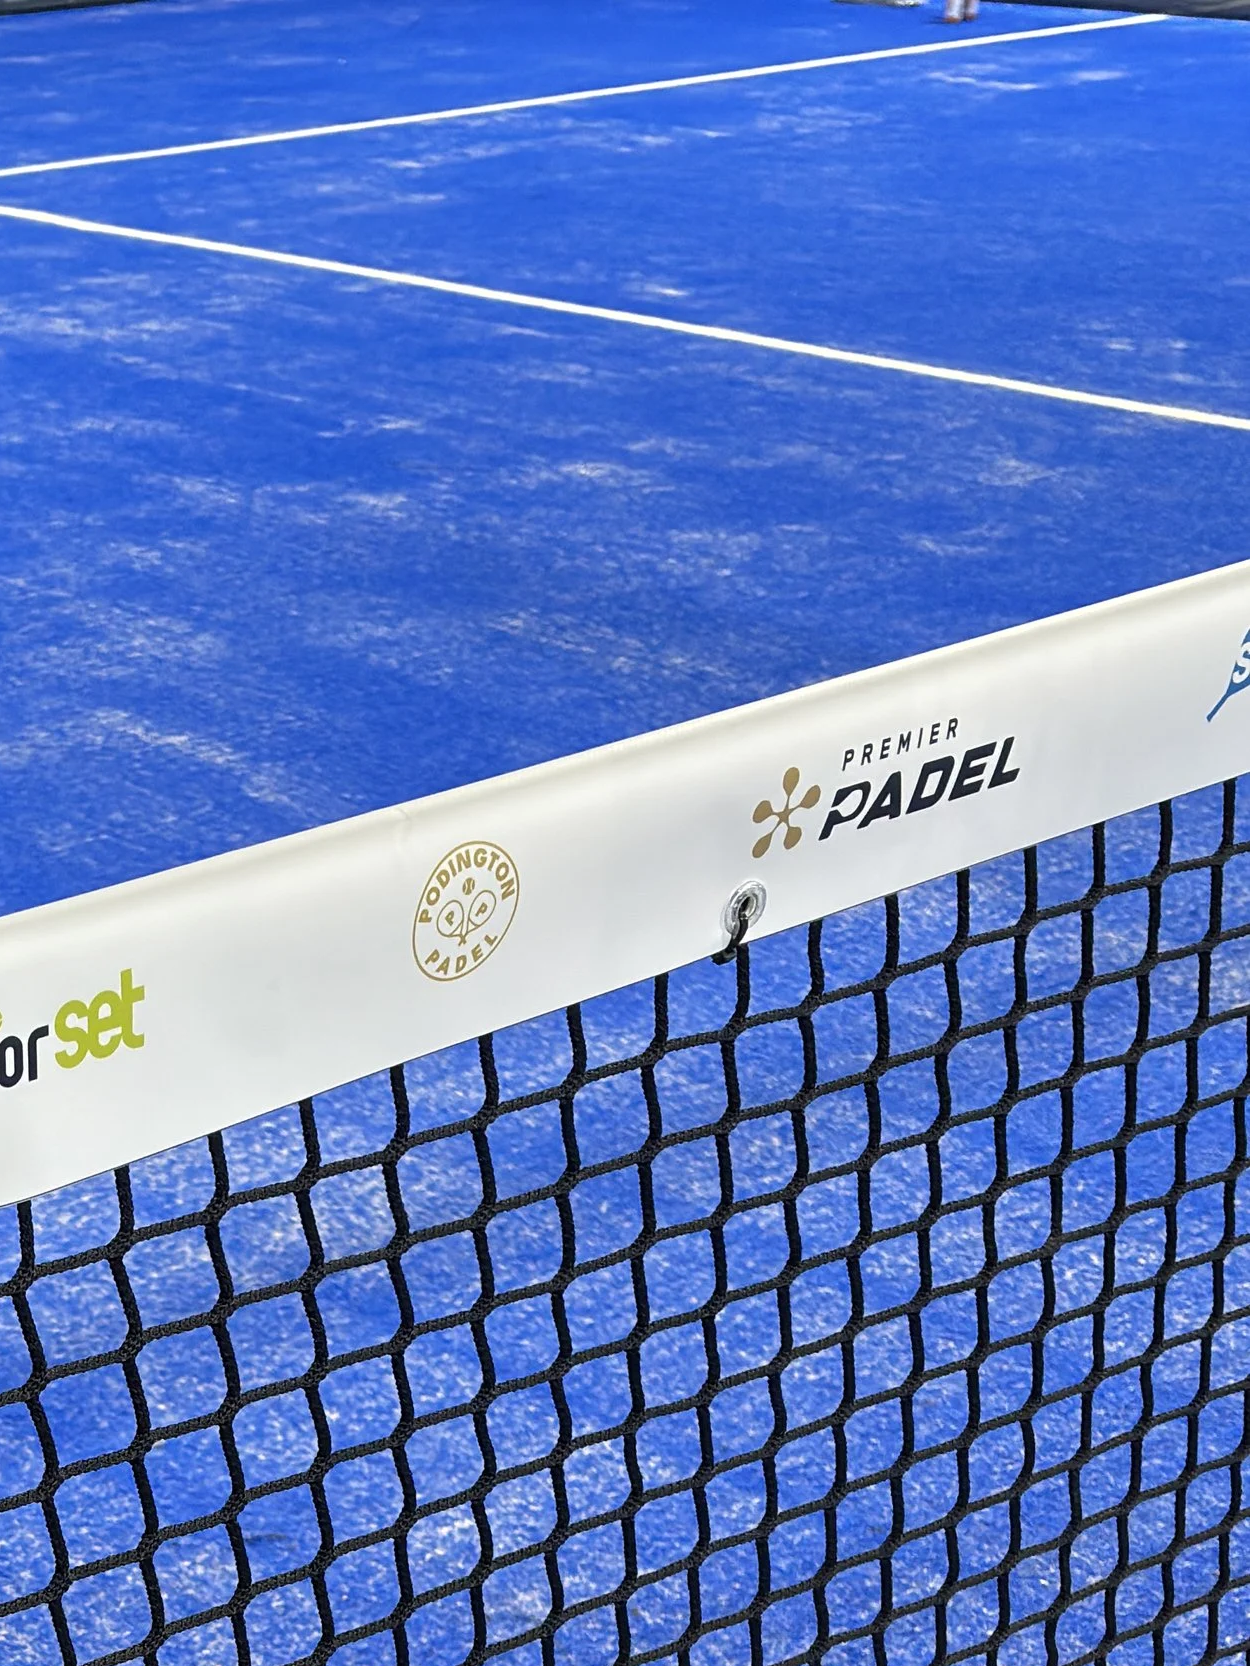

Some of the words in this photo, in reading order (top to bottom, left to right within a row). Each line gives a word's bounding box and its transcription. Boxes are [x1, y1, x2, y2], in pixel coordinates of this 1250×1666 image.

[842, 718, 959, 771] PREMIER
[818, 737, 1020, 841] PADEL
[418, 848, 515, 923] PODINGTON
[424, 934, 498, 975] PADEL
